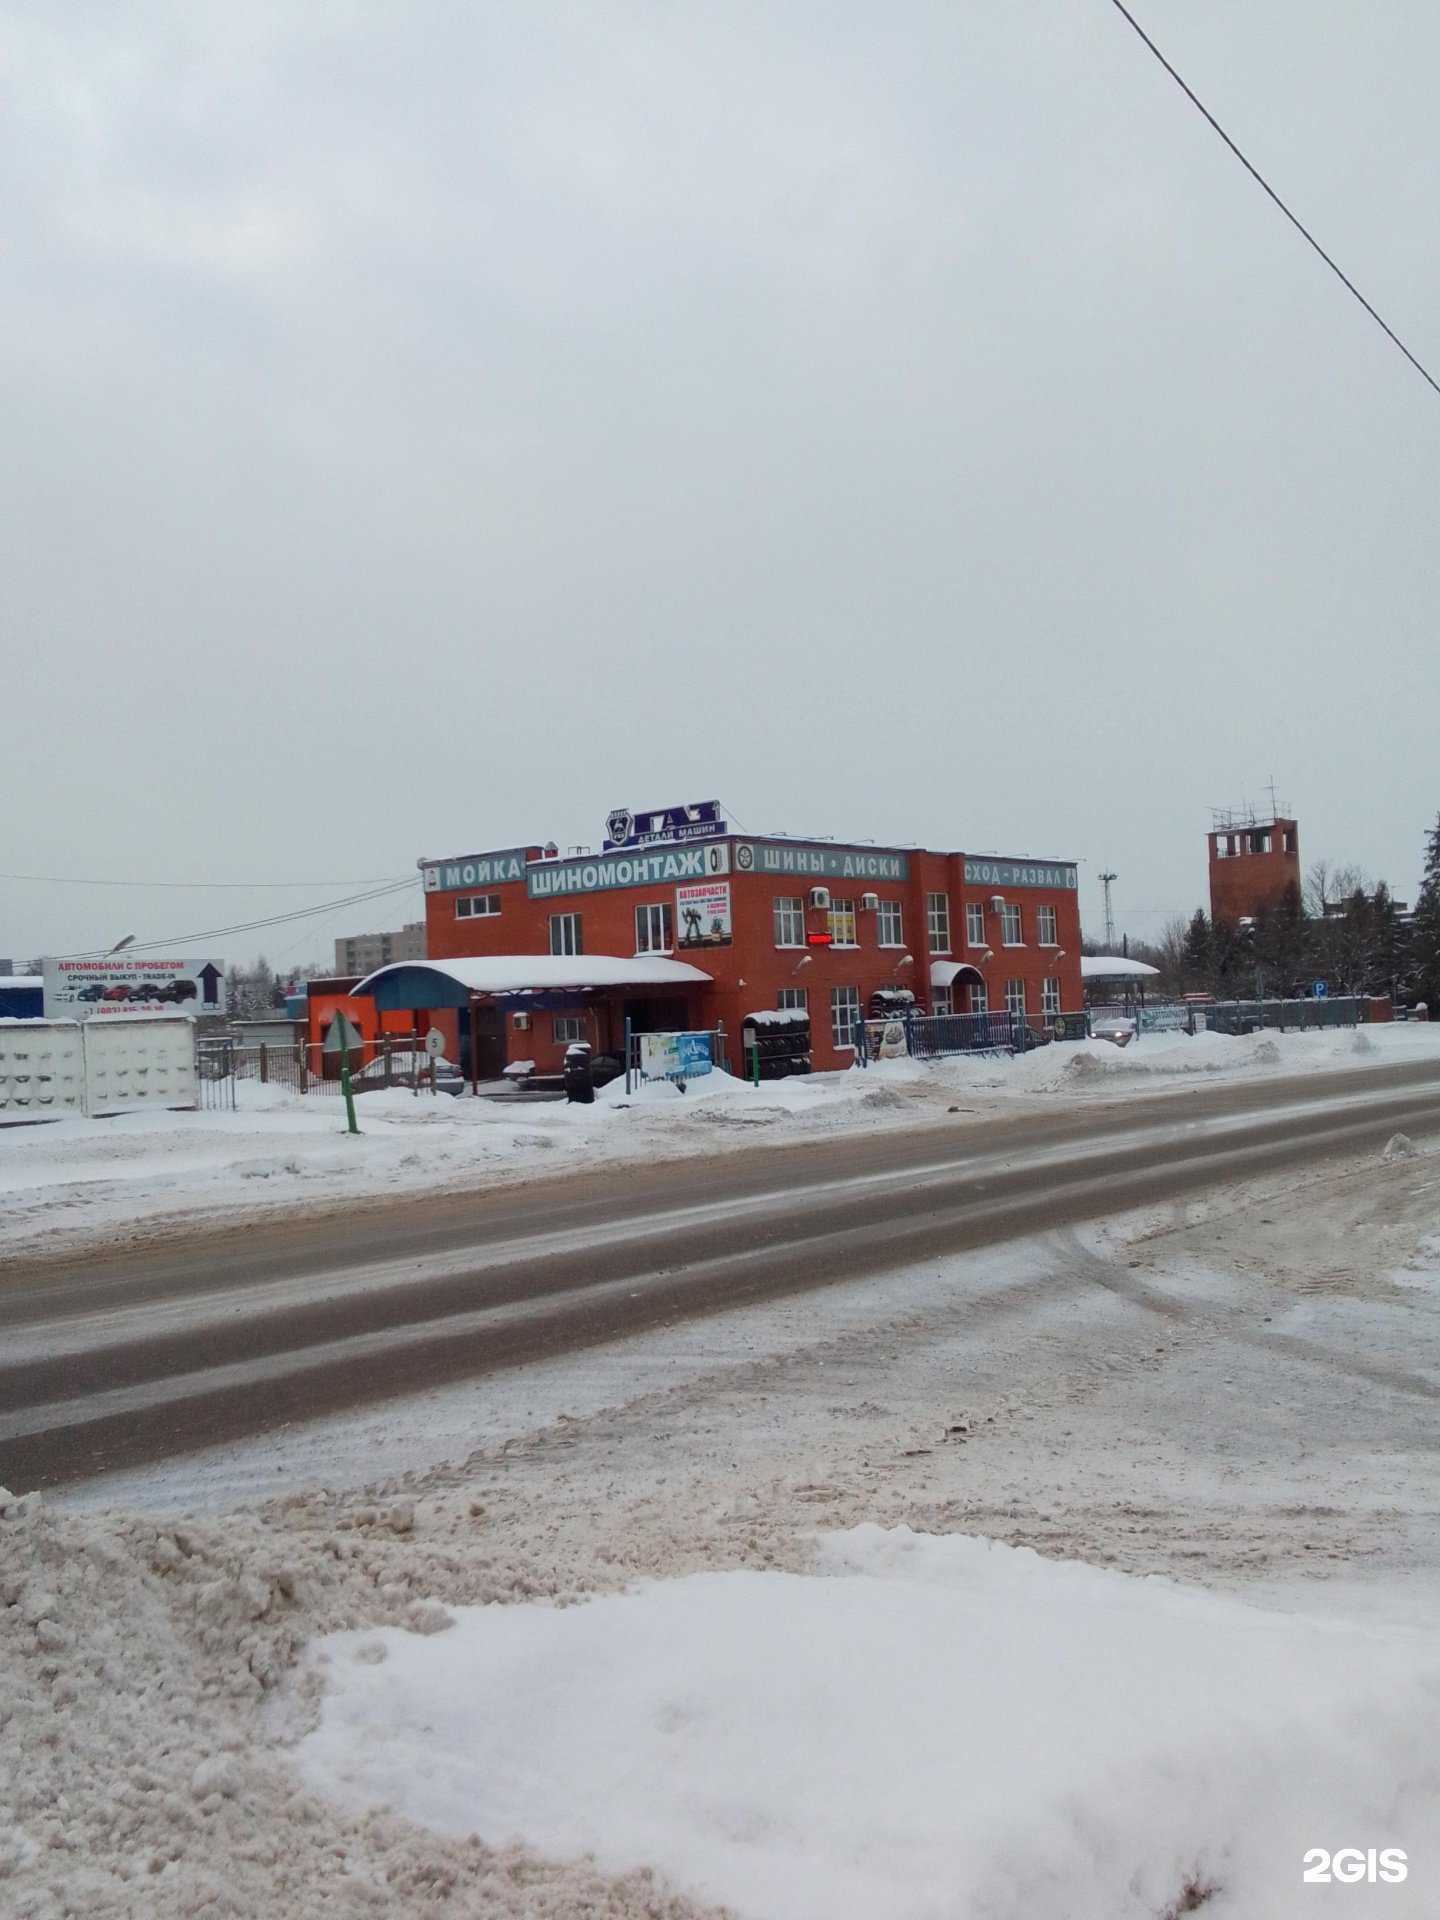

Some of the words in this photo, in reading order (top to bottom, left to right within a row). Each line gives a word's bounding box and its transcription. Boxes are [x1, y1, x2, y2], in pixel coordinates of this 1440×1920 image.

[638, 831, 674, 844] ДЕТАЛИ
[678, 823, 716, 838] МАШИН
[446, 858, 521, 886] МОЙКА
[532, 850, 703, 895] ШИНОМОНТАЖ
[764, 849, 825, 873] ШИНЫ
[843, 855, 900, 877] ДИСКИ
[58, 962, 124, 971] АВТОМОБИЛИ
[126, 962, 132, 970] С
[134, 961, 185, 970] ПРОБЕГОМ
[67, 973, 108, 981] СРОЧНЫЙ
[1315, 983, 1325, 995] P
